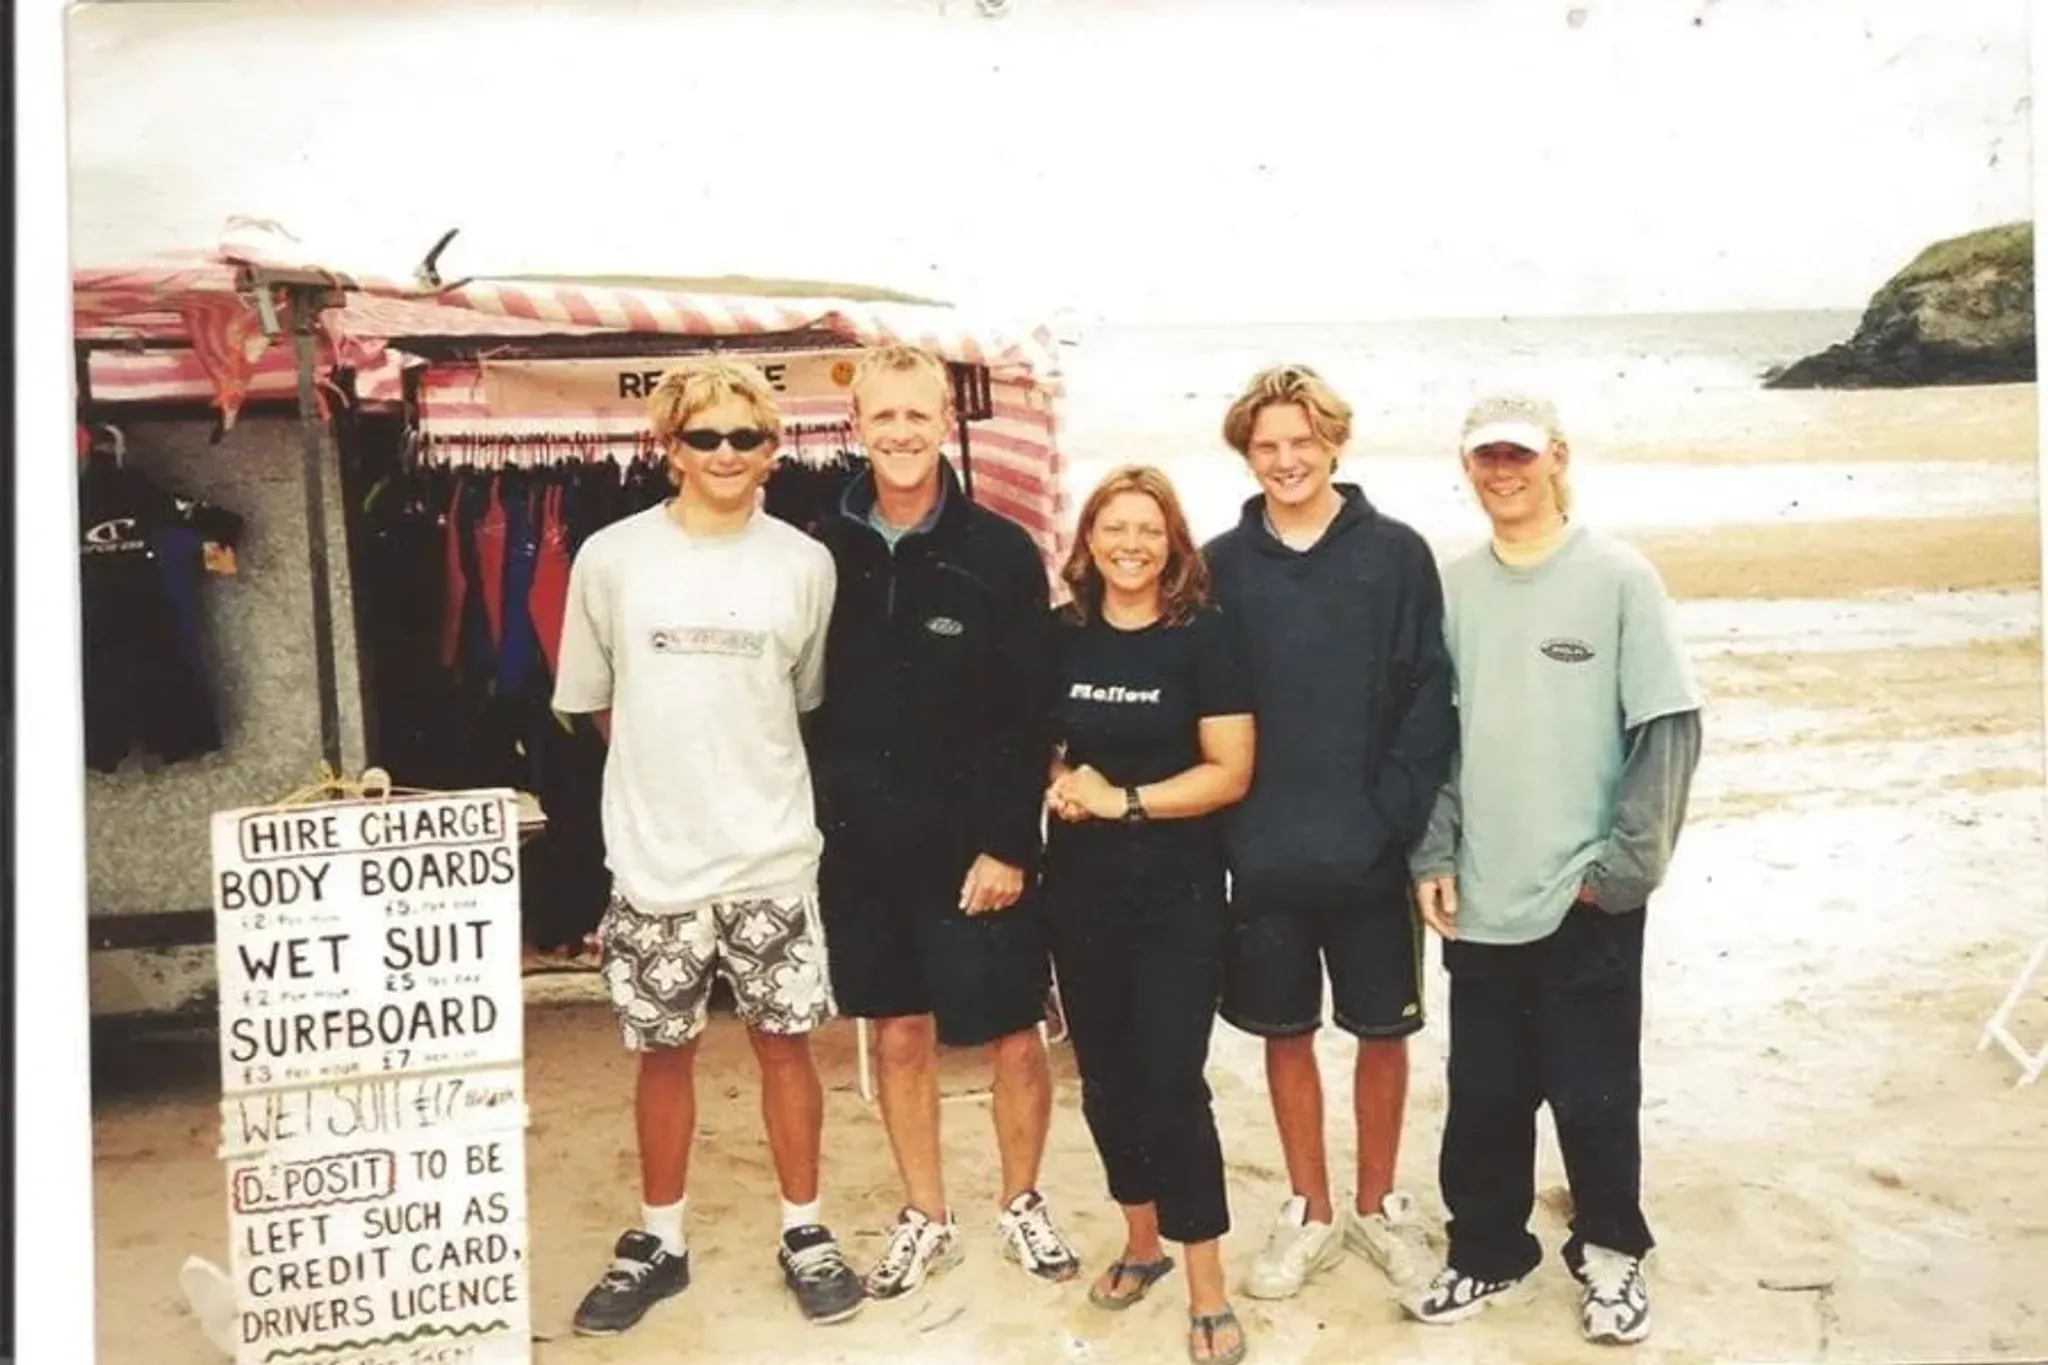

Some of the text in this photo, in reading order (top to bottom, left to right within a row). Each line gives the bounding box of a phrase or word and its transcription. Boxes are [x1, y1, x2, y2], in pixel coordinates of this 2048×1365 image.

[250, 802, 498, 853] HIRE CHARGE
[221, 847, 514, 910] BODY BOARDS
[238, 920, 492, 982] WET SUIT
[231, 995, 497, 1062] SURFBOARD
[411, 1149, 447, 1181] TO
[466, 1142, 504, 1175] BE
[247, 1192, 509, 1256] LEFT SUCH AS
[248, 1247, 390, 1298] CREDIT
[242, 1274, 518, 1344] DRIVERS LICENCE
